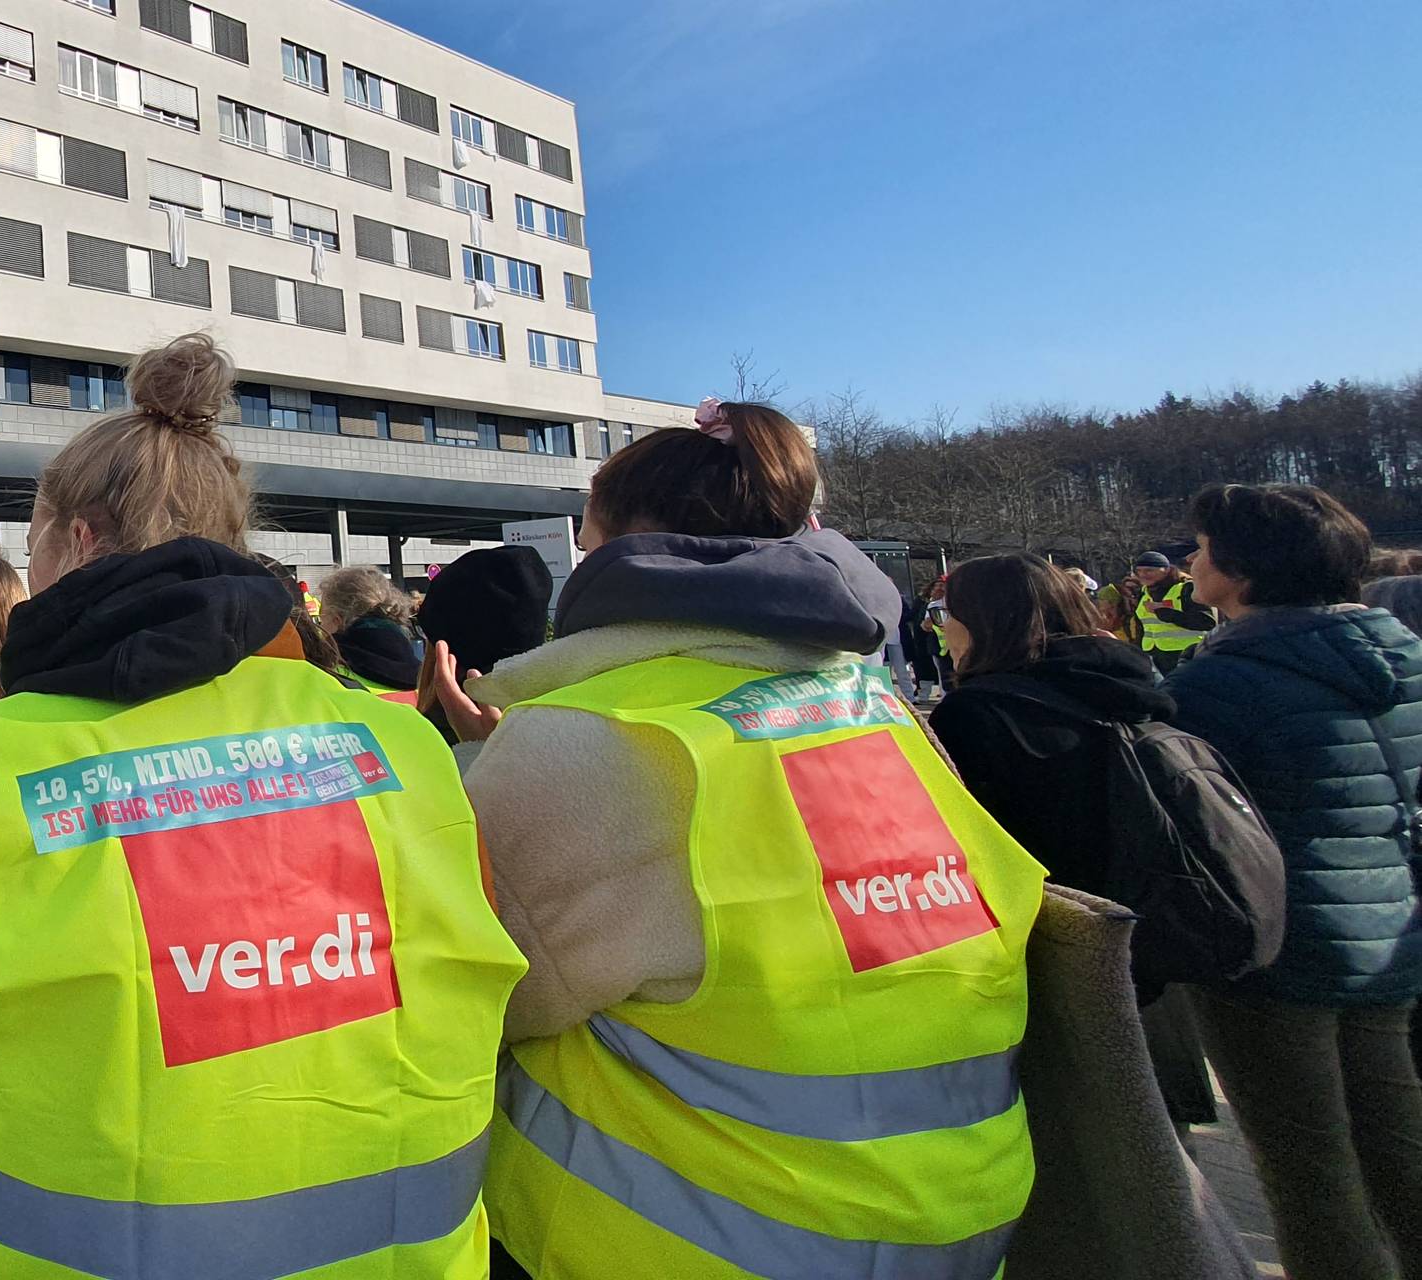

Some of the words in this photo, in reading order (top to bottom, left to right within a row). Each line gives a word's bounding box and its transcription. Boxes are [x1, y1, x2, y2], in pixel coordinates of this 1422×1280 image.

[732, 711, 766, 730] IST
[763, 707, 802, 729] MEHR
[132, 746, 226, 786] MIND.
[226, 735, 284, 772] 500
[286, 732, 308, 765] €
[311, 732, 367, 761] MEHR
[42, 806, 88, 839] IST
[91, 795, 151, 827] MEHR
[152, 786, 199, 818] FÜR
[198, 782, 244, 811] UNS
[246, 772, 309, 803] ALLE!
[835, 855, 973, 916] ver.di
[168, 913, 376, 993] ver.di
